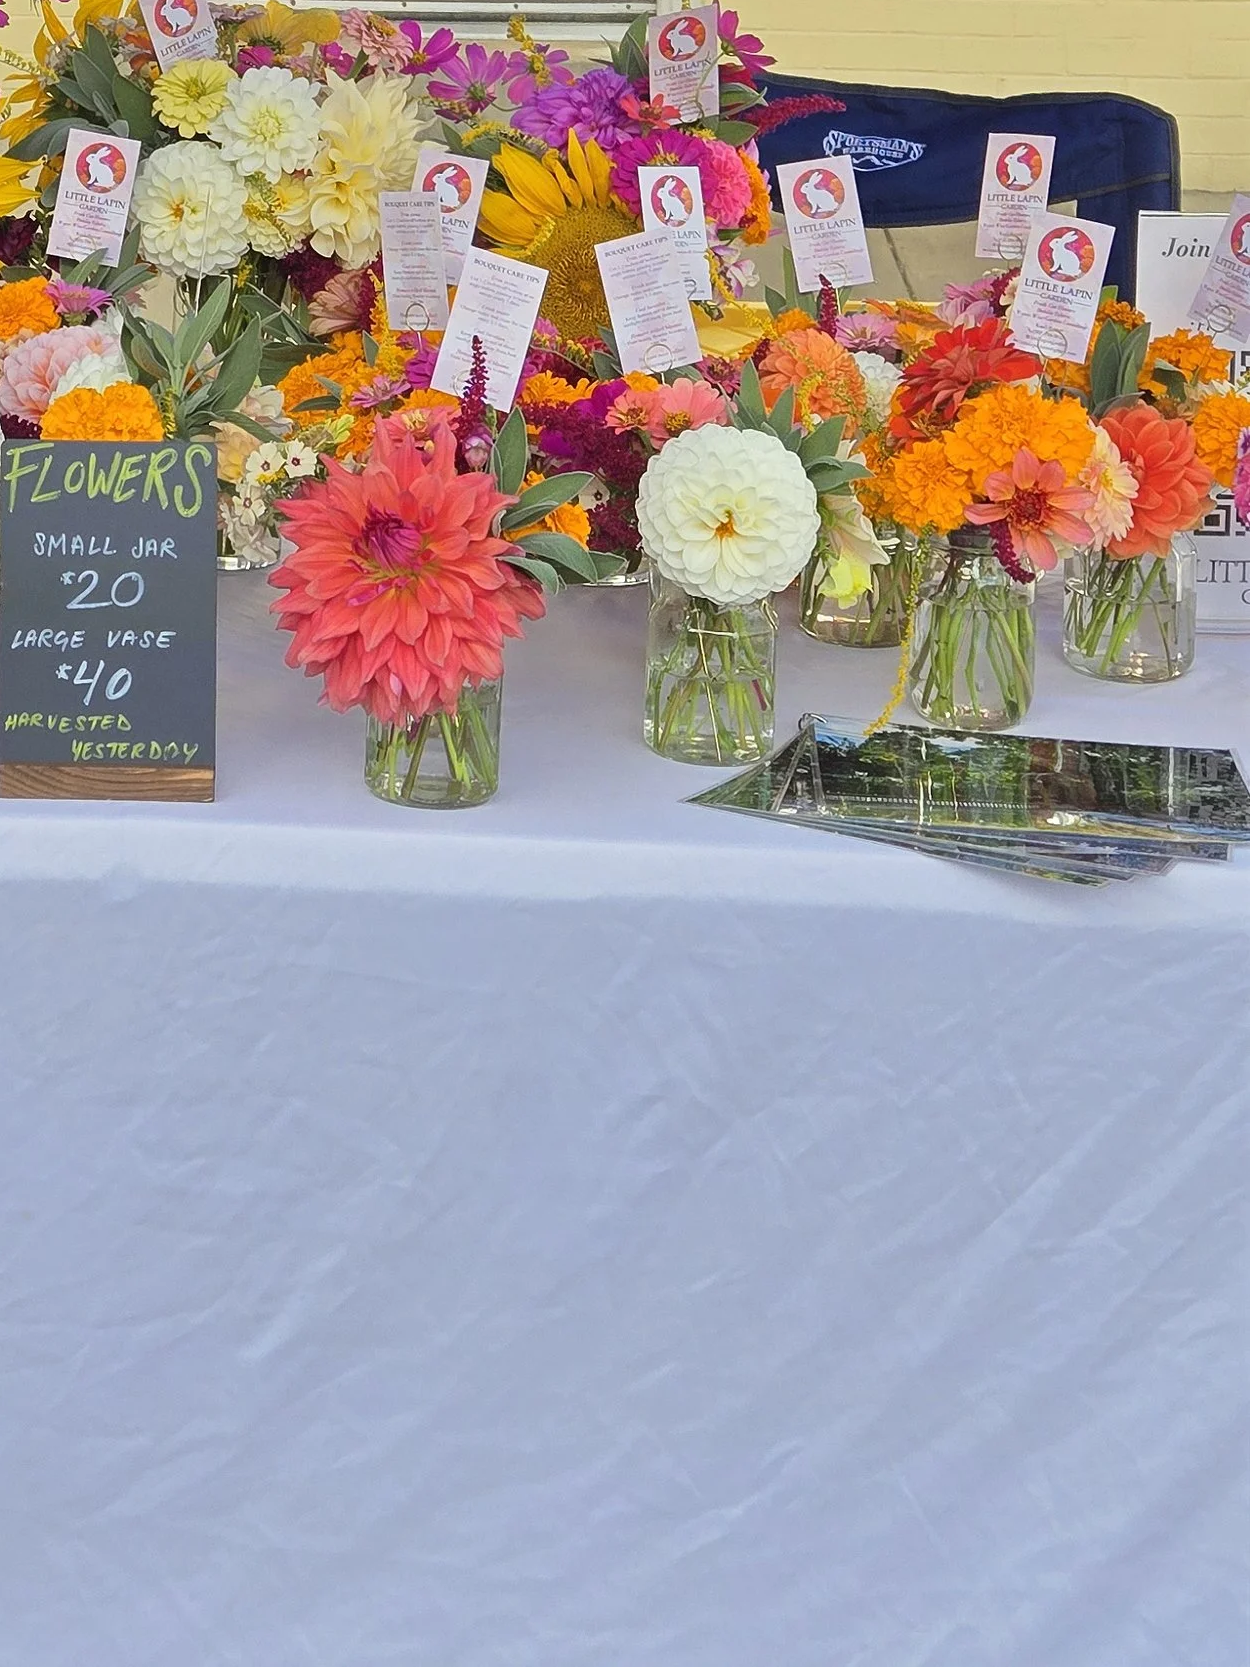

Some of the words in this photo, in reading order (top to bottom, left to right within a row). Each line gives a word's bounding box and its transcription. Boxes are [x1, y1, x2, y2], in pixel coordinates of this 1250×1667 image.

[823, 130, 924, 161] SPORTSMAN'S
[65, 191, 96, 203] LITTLE
[987, 194, 1016, 202] LITTLE
[1016, 195, 1043, 203] LAPIN
[794, 222, 827, 235] LITTLE
[828, 218, 856, 229] LAPIN
[1161, 237, 1212, 258] Join
[1024, 278, 1058, 294] LITTLE
[1060, 284, 1093, 300] LAPIN
[4, 443, 212, 518] FLOWERS
[33, 533, 116, 558] SMALL
[131, 536, 178, 559] JAR
[60, 570, 145, 610] $20
[11, 629, 86, 652] LARGE
[107, 630, 177, 650] VASE
[56, 659, 133, 705] $40
[5, 713, 132, 733] HARVESTED
[71, 741, 199, 764] YESTERDAY
